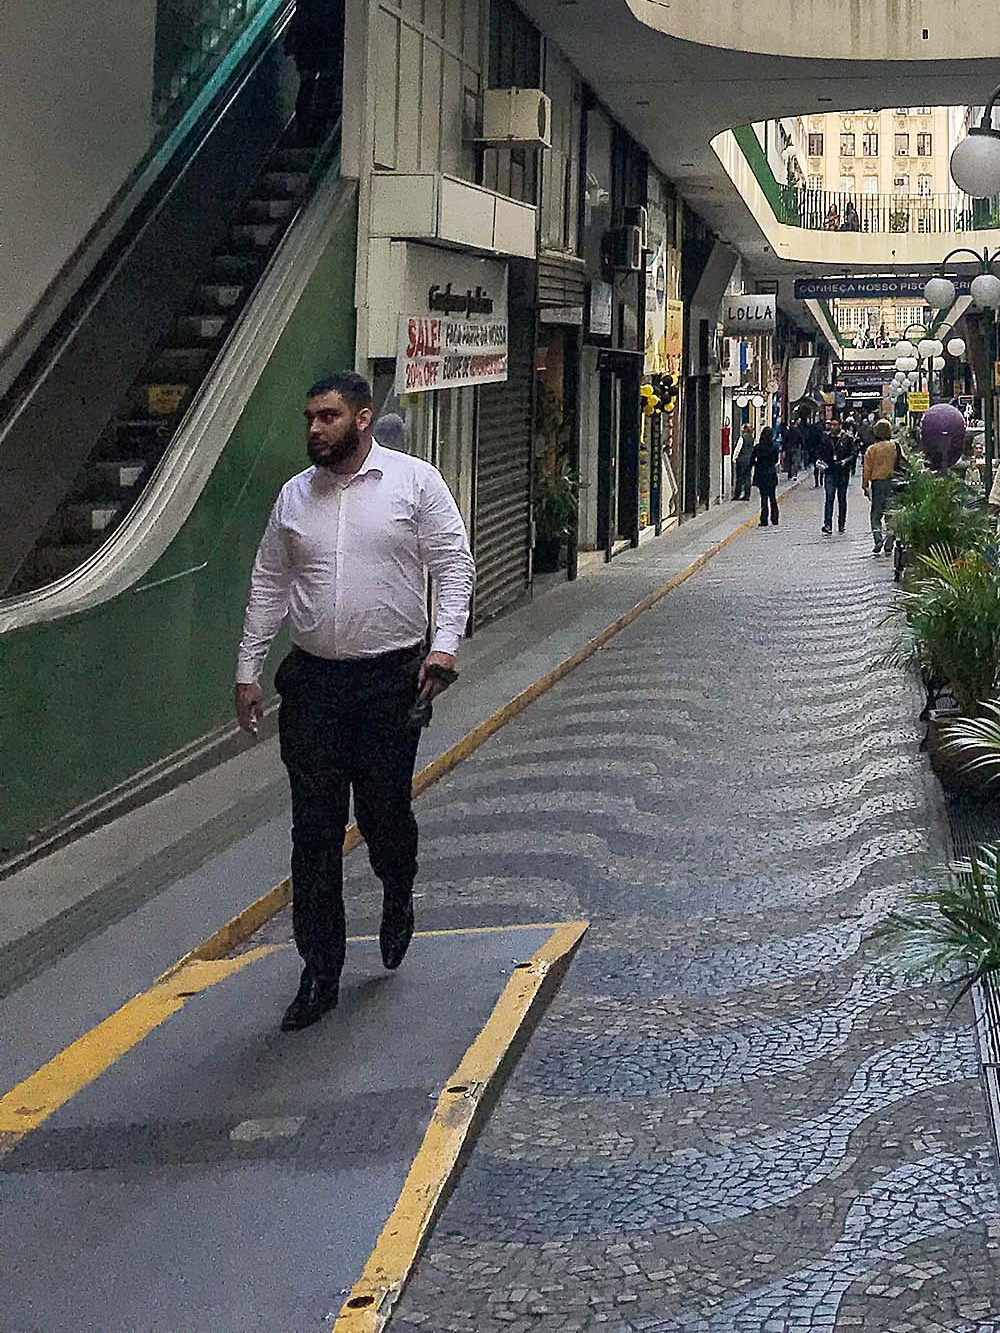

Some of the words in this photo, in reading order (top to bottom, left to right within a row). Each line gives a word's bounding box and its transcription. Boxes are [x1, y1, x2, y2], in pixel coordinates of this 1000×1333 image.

[800, 282, 856, 294] CONHEÇA
[857, 281, 898, 292] NOSSO
[728, 305, 773, 321] LOLLA
[406, 318, 442, 359] SALE!
